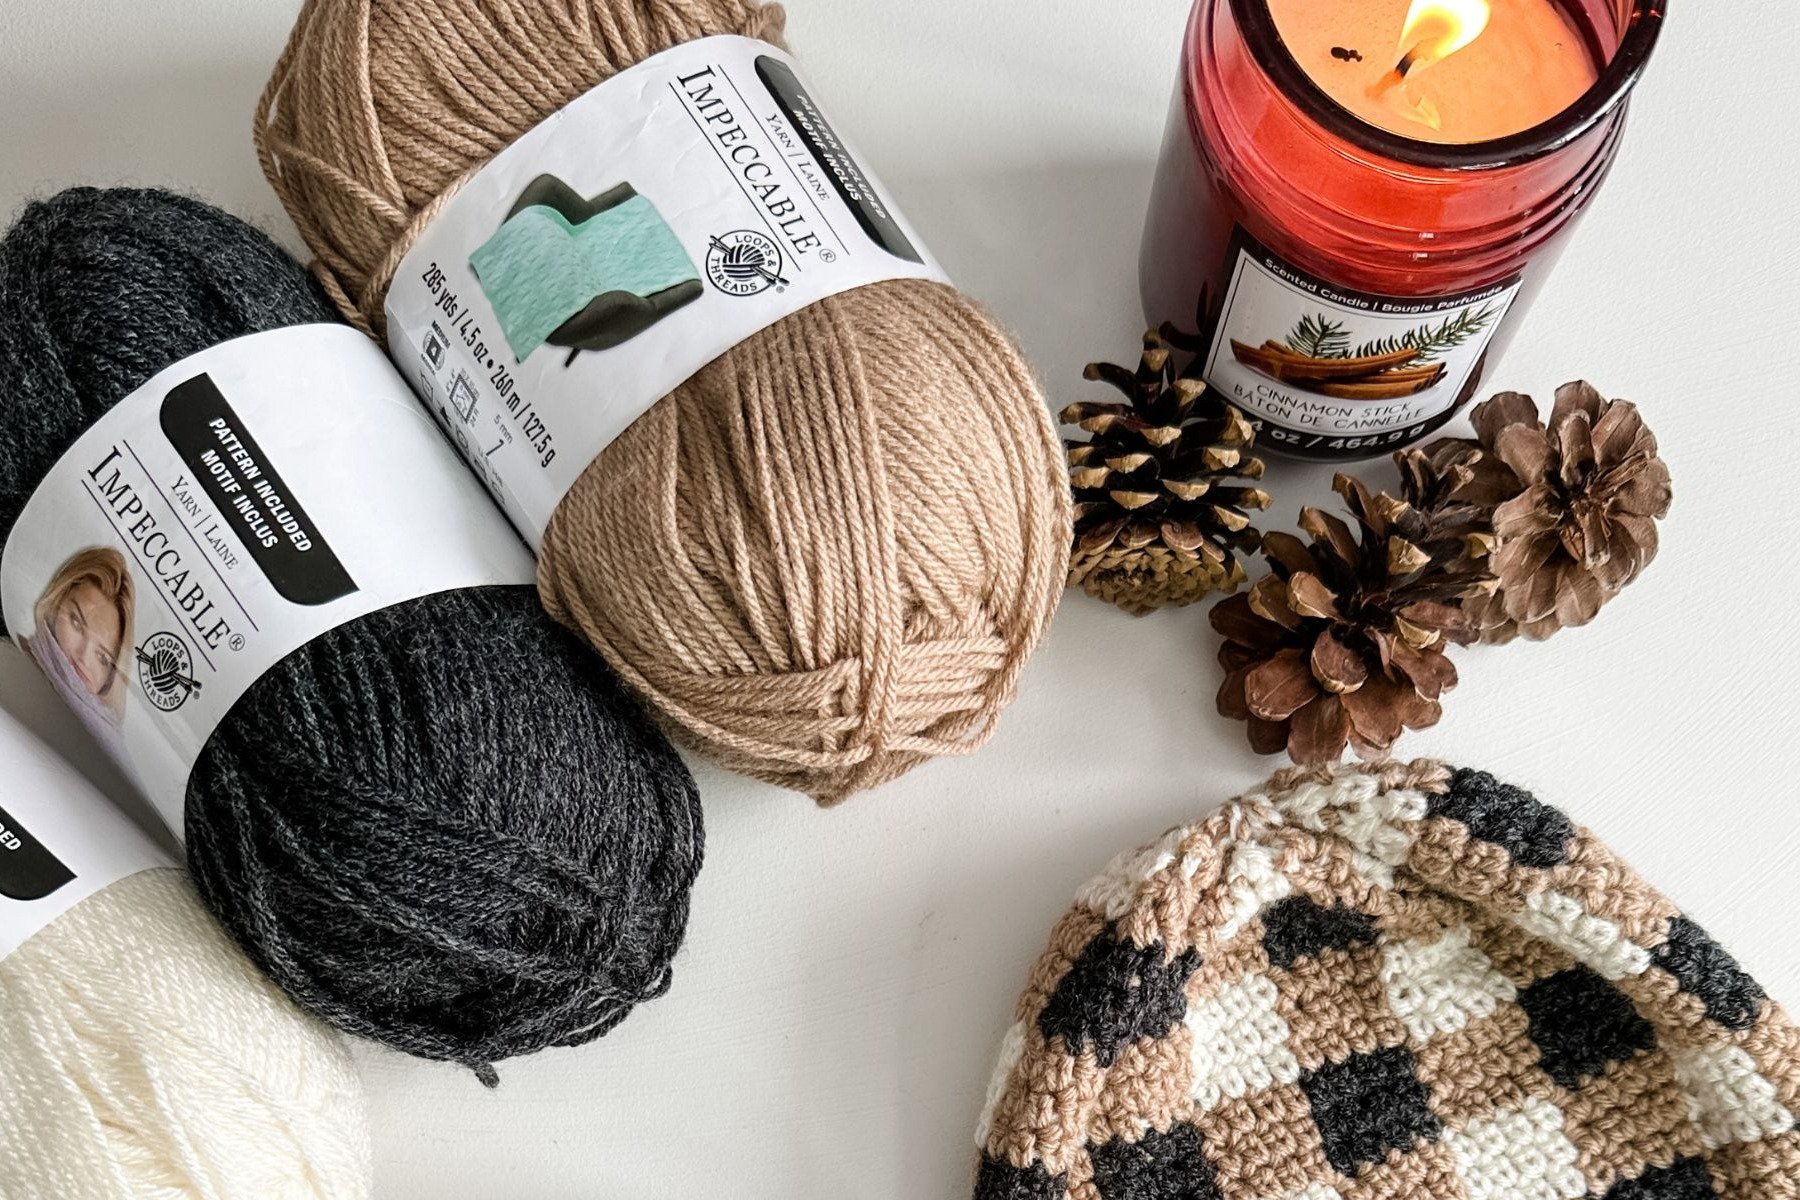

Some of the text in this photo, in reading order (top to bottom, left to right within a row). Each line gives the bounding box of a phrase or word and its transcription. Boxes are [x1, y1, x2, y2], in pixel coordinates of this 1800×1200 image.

[765, 114, 795, 149] YARN
[797, 161, 831, 201] LAINE
[793, 110, 862, 201] MOTIF INCLUS
[797, 94, 886, 219] PATTERN INCLUDED
[735, 234, 775, 257] LOOPS
[422, 262, 447, 295] 285
[711, 257, 758, 292] THREADS
[1264, 258, 1317, 293] Scented
[1320, 288, 1369, 309] Candle
[1382, 303, 1433, 313] Bougie
[434, 288, 458, 317] yds
[460, 318, 482, 347] 4.5
[473, 342, 489, 364] oz
[490, 365, 515, 398] 260
[506, 391, 521, 413] m
[1256, 384, 1411, 417] CINNAMON STICK
[493, 414, 513, 444] 5 mm
[522, 412, 553, 454] 127.5
[1300, 413, 1324, 426] DE
[1334, 407, 1424, 430] CANNELLE
[1271, 429, 1301, 445] oz
[1328, 431, 1403, 449] 464.9
[541, 448, 556, 468] g
[200, 449, 279, 549] MOTIF INCLUS
[208, 417, 313, 553] PATTERN INCLUDED
[171, 475, 202, 519] YARN
[200, 522, 239, 571] LAINE
[151, 637, 189, 671] LOOPS &
[142, 670, 181, 707] THREADS
